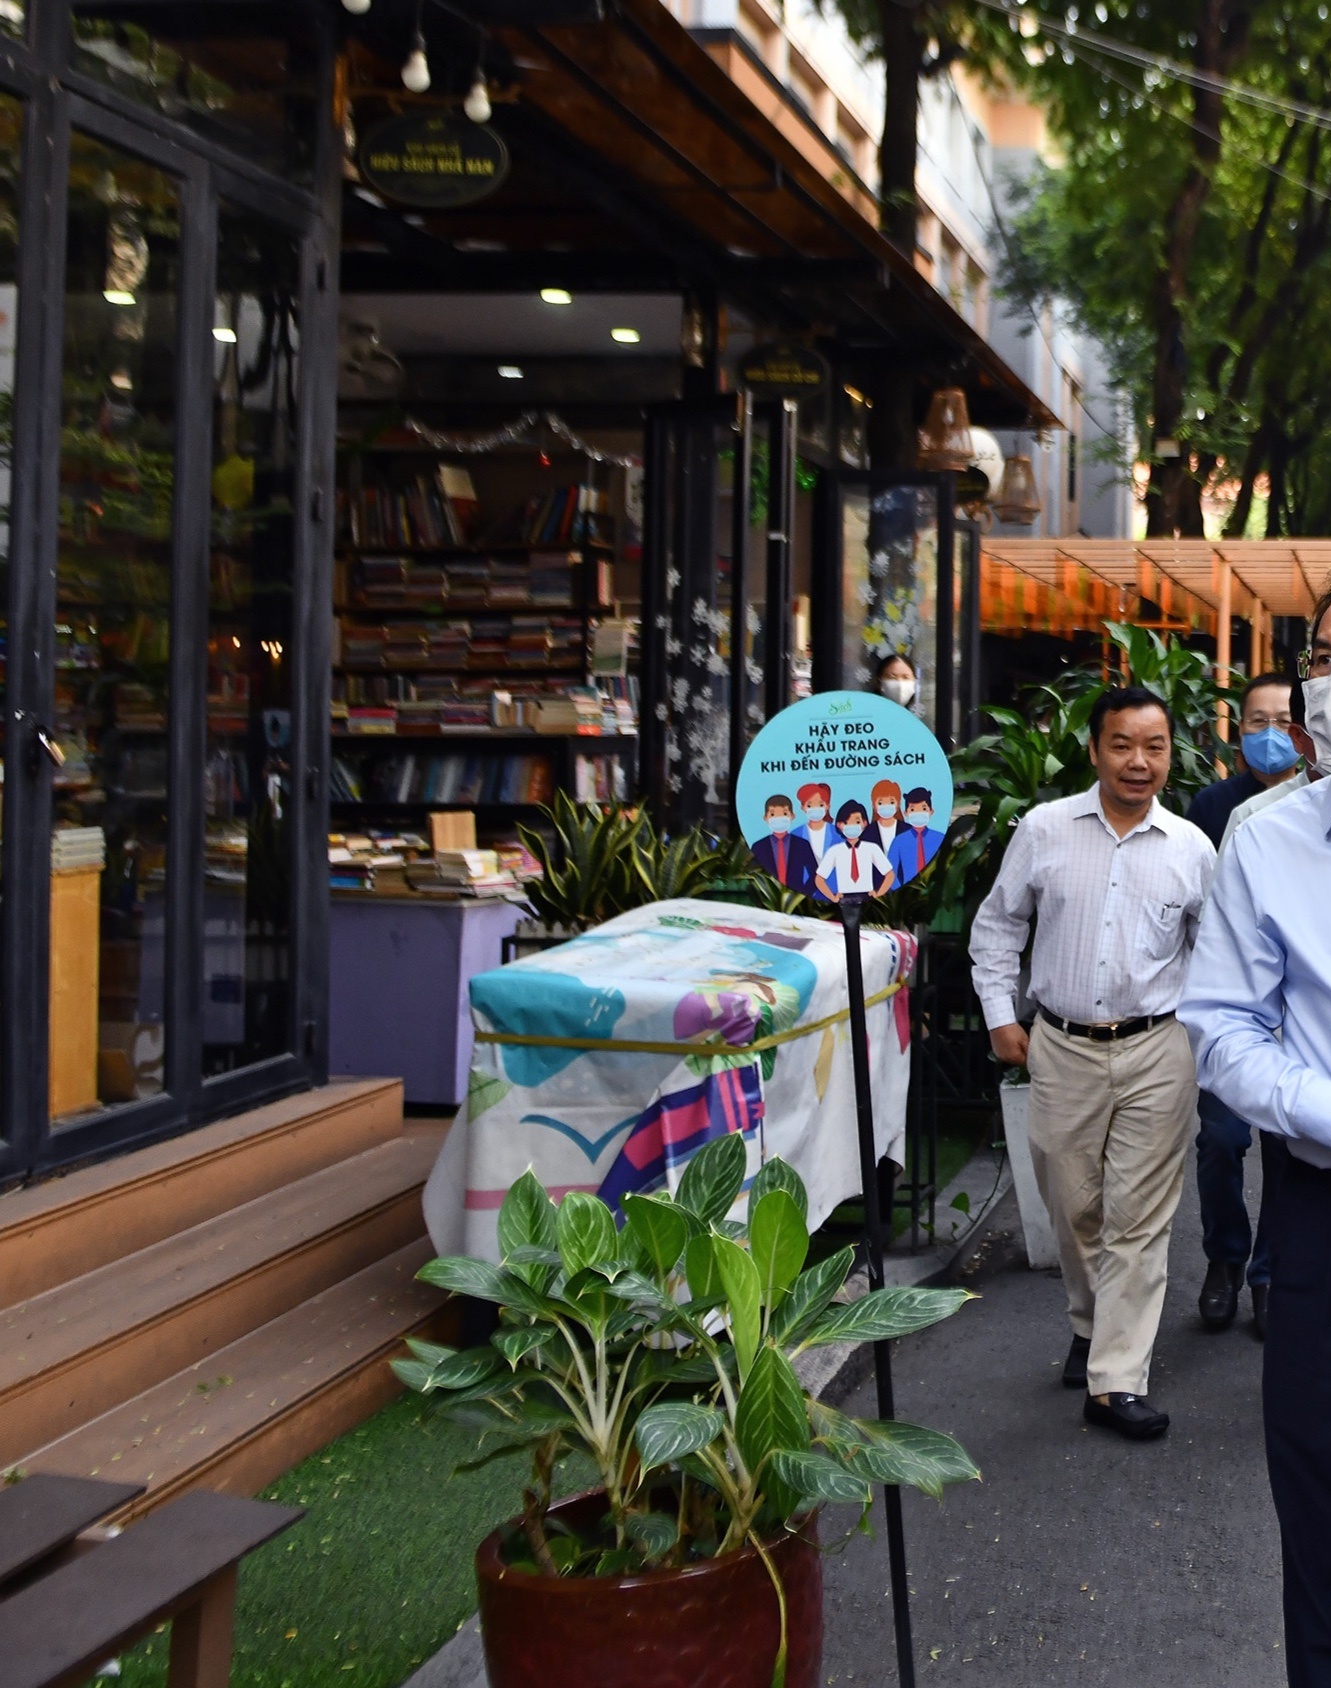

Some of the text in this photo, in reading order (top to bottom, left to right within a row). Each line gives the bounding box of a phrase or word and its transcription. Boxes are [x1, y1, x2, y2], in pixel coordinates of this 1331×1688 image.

[809, 722, 875, 737] HÃY ĐEO
[840, 738, 890, 752] TRANG
[760, 751, 926, 773] KHI ĐẾN ĐƯỜNG SÁCH
